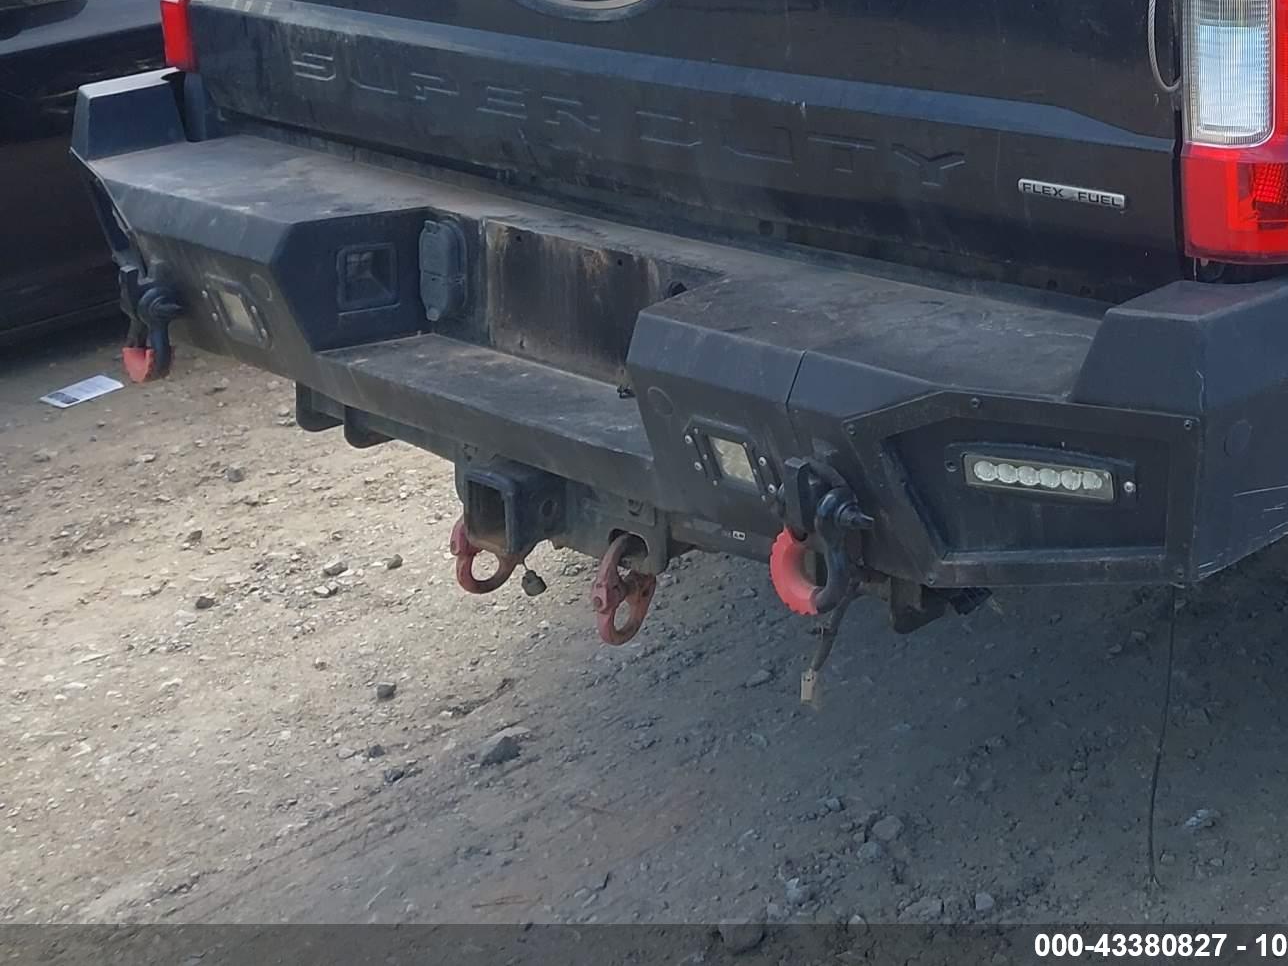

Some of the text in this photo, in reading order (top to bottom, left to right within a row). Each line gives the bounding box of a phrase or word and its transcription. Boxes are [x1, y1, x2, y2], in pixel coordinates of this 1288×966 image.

[291, 51, 967, 187] SUPER DUTY
[1022, 181, 1122, 207] FLEX FUEL
